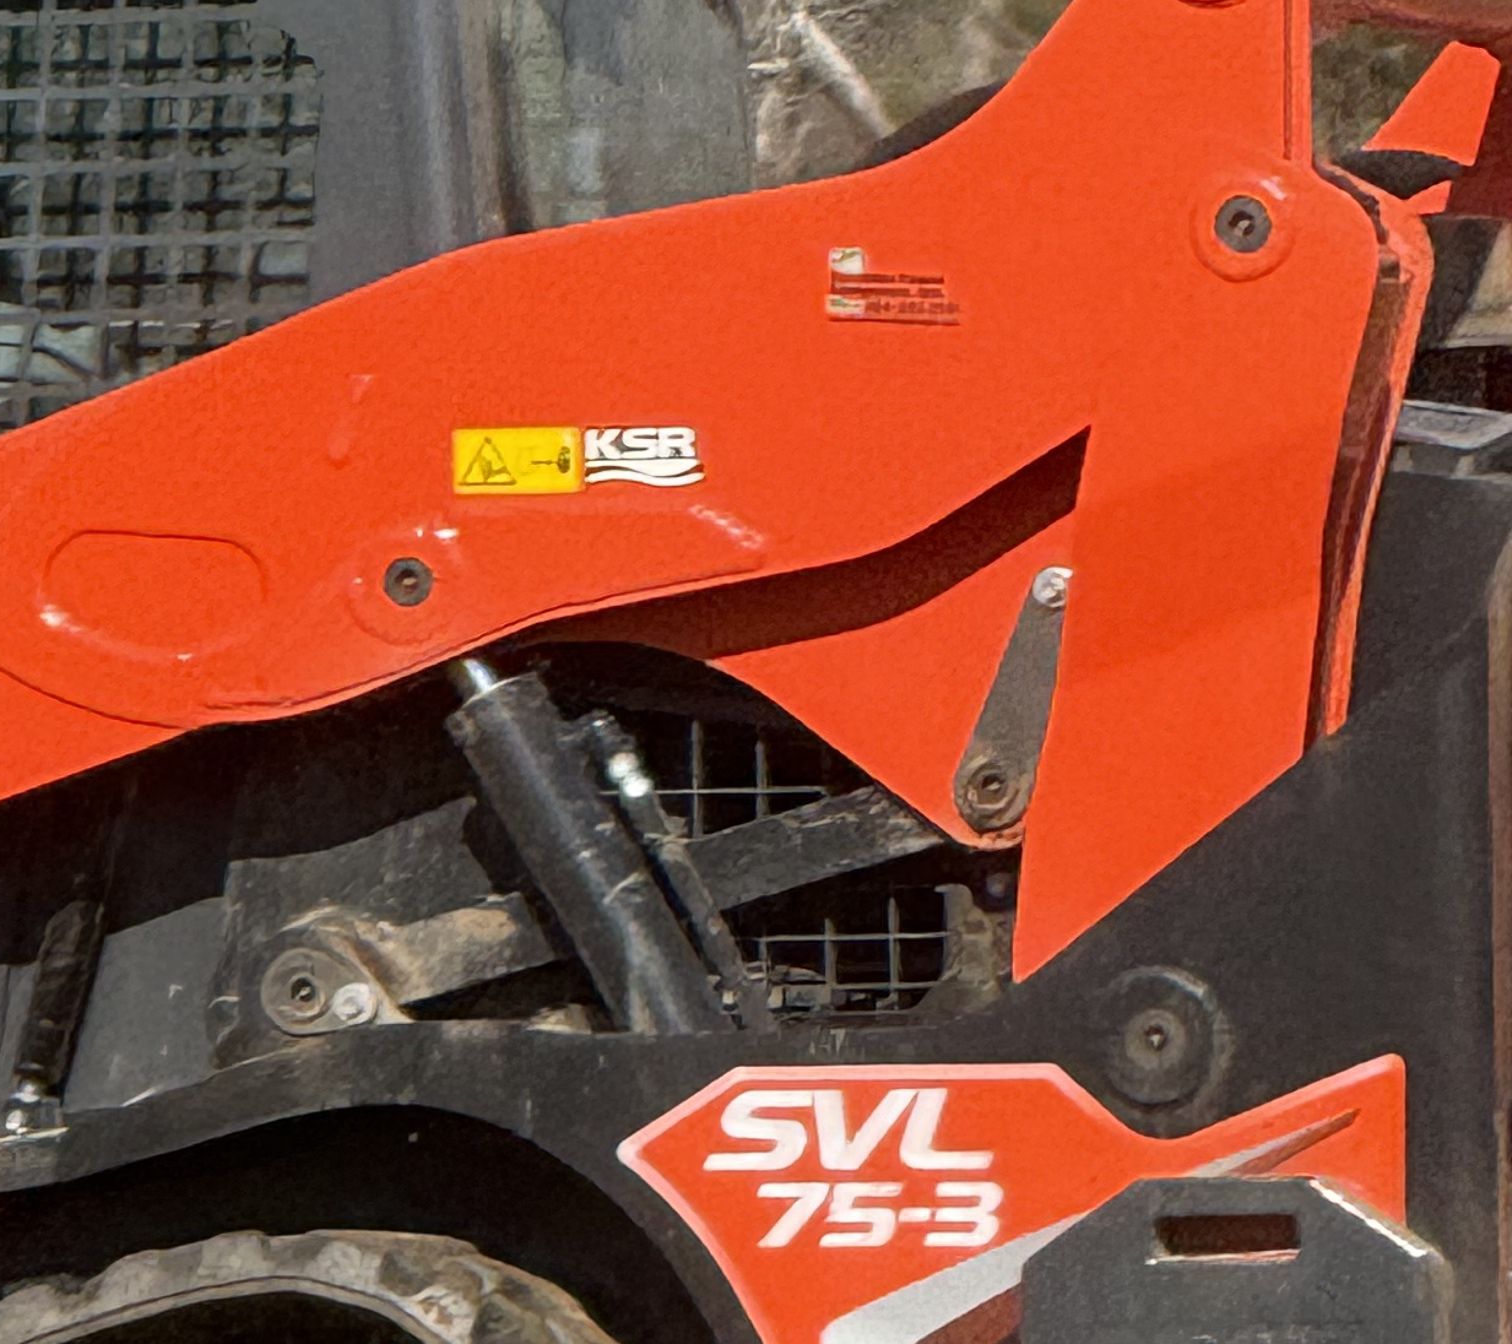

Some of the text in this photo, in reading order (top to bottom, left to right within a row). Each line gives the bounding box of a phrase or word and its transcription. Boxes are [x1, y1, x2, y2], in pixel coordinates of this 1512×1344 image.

[584, 427, 696, 459] KSR
[703, 1087, 995, 1171] SVL
[756, 1181, 1004, 1248] 75-3
